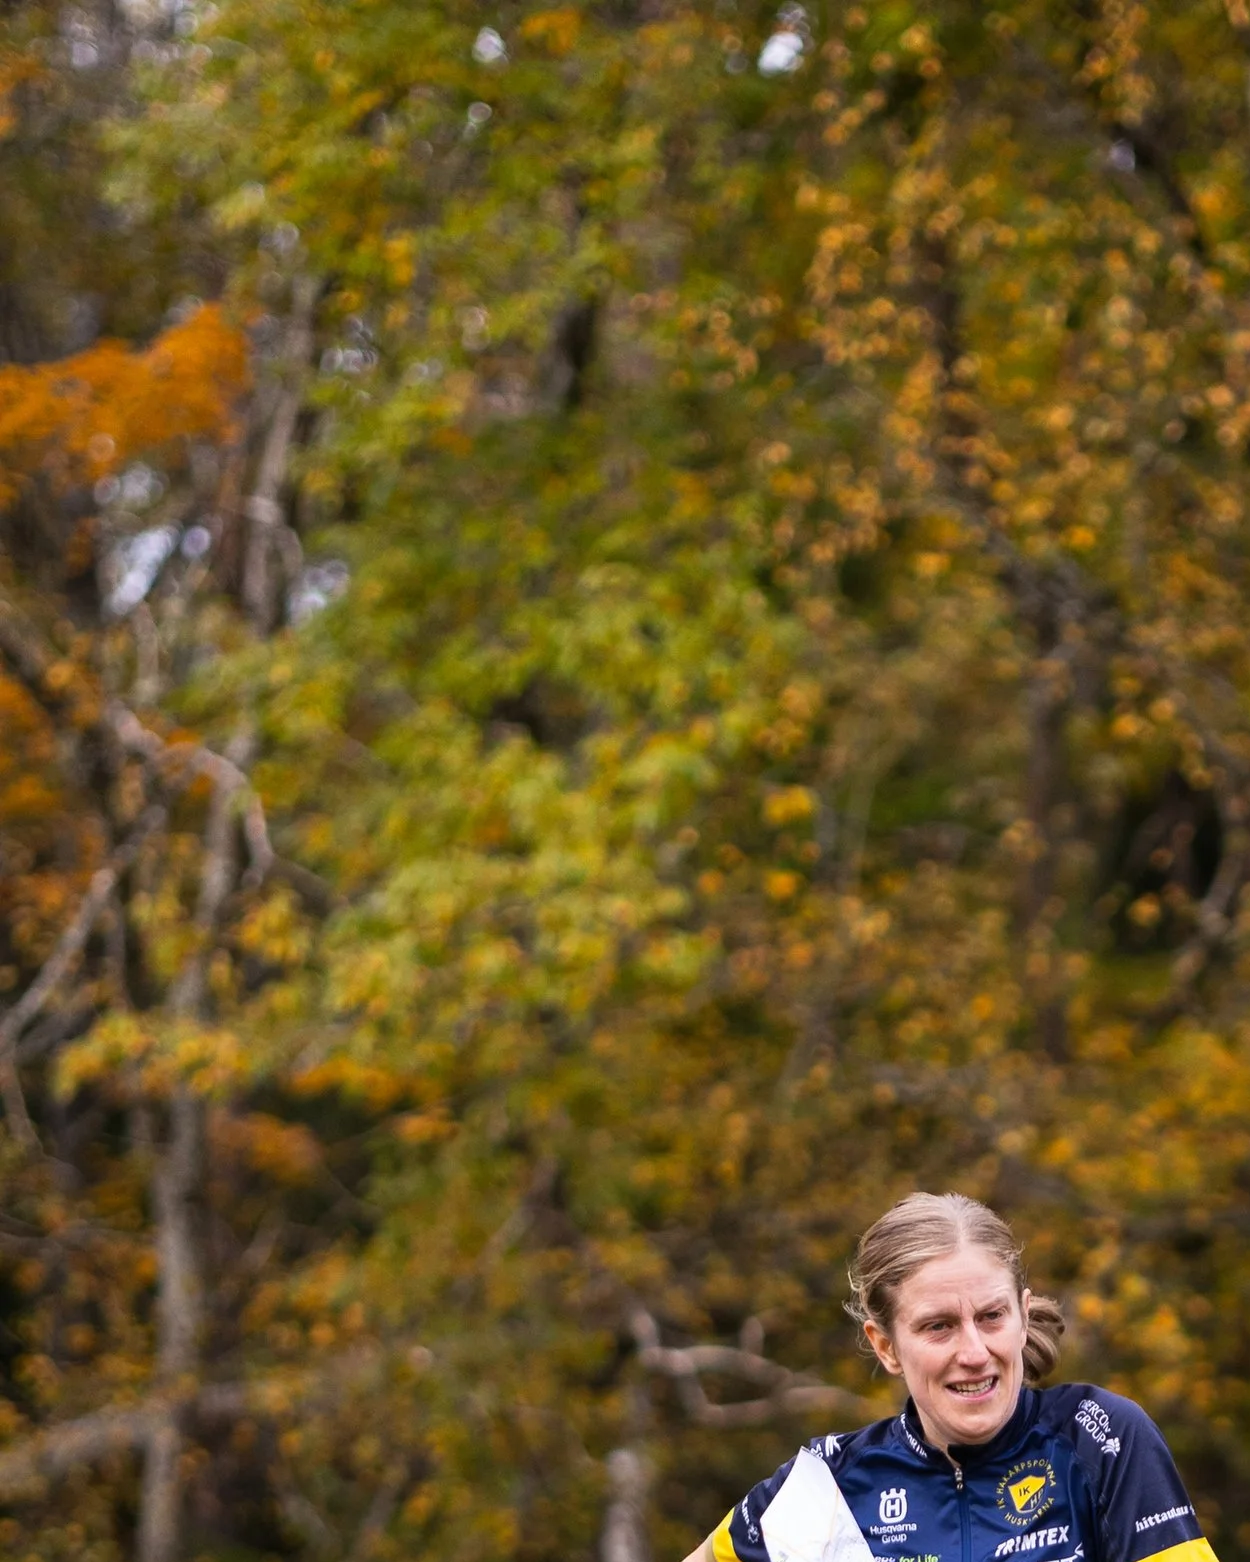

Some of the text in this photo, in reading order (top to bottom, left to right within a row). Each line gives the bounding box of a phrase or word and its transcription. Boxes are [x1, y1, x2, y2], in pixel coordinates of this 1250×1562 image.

[1075, 1410, 1106, 1443] GROUP
[1018, 1485, 1031, 1497] IK
[869, 1523, 917, 1536] Husqvarna
[881, 1533, 907, 1545] Group
[995, 1525, 1070, 1557] TRIMTEX
